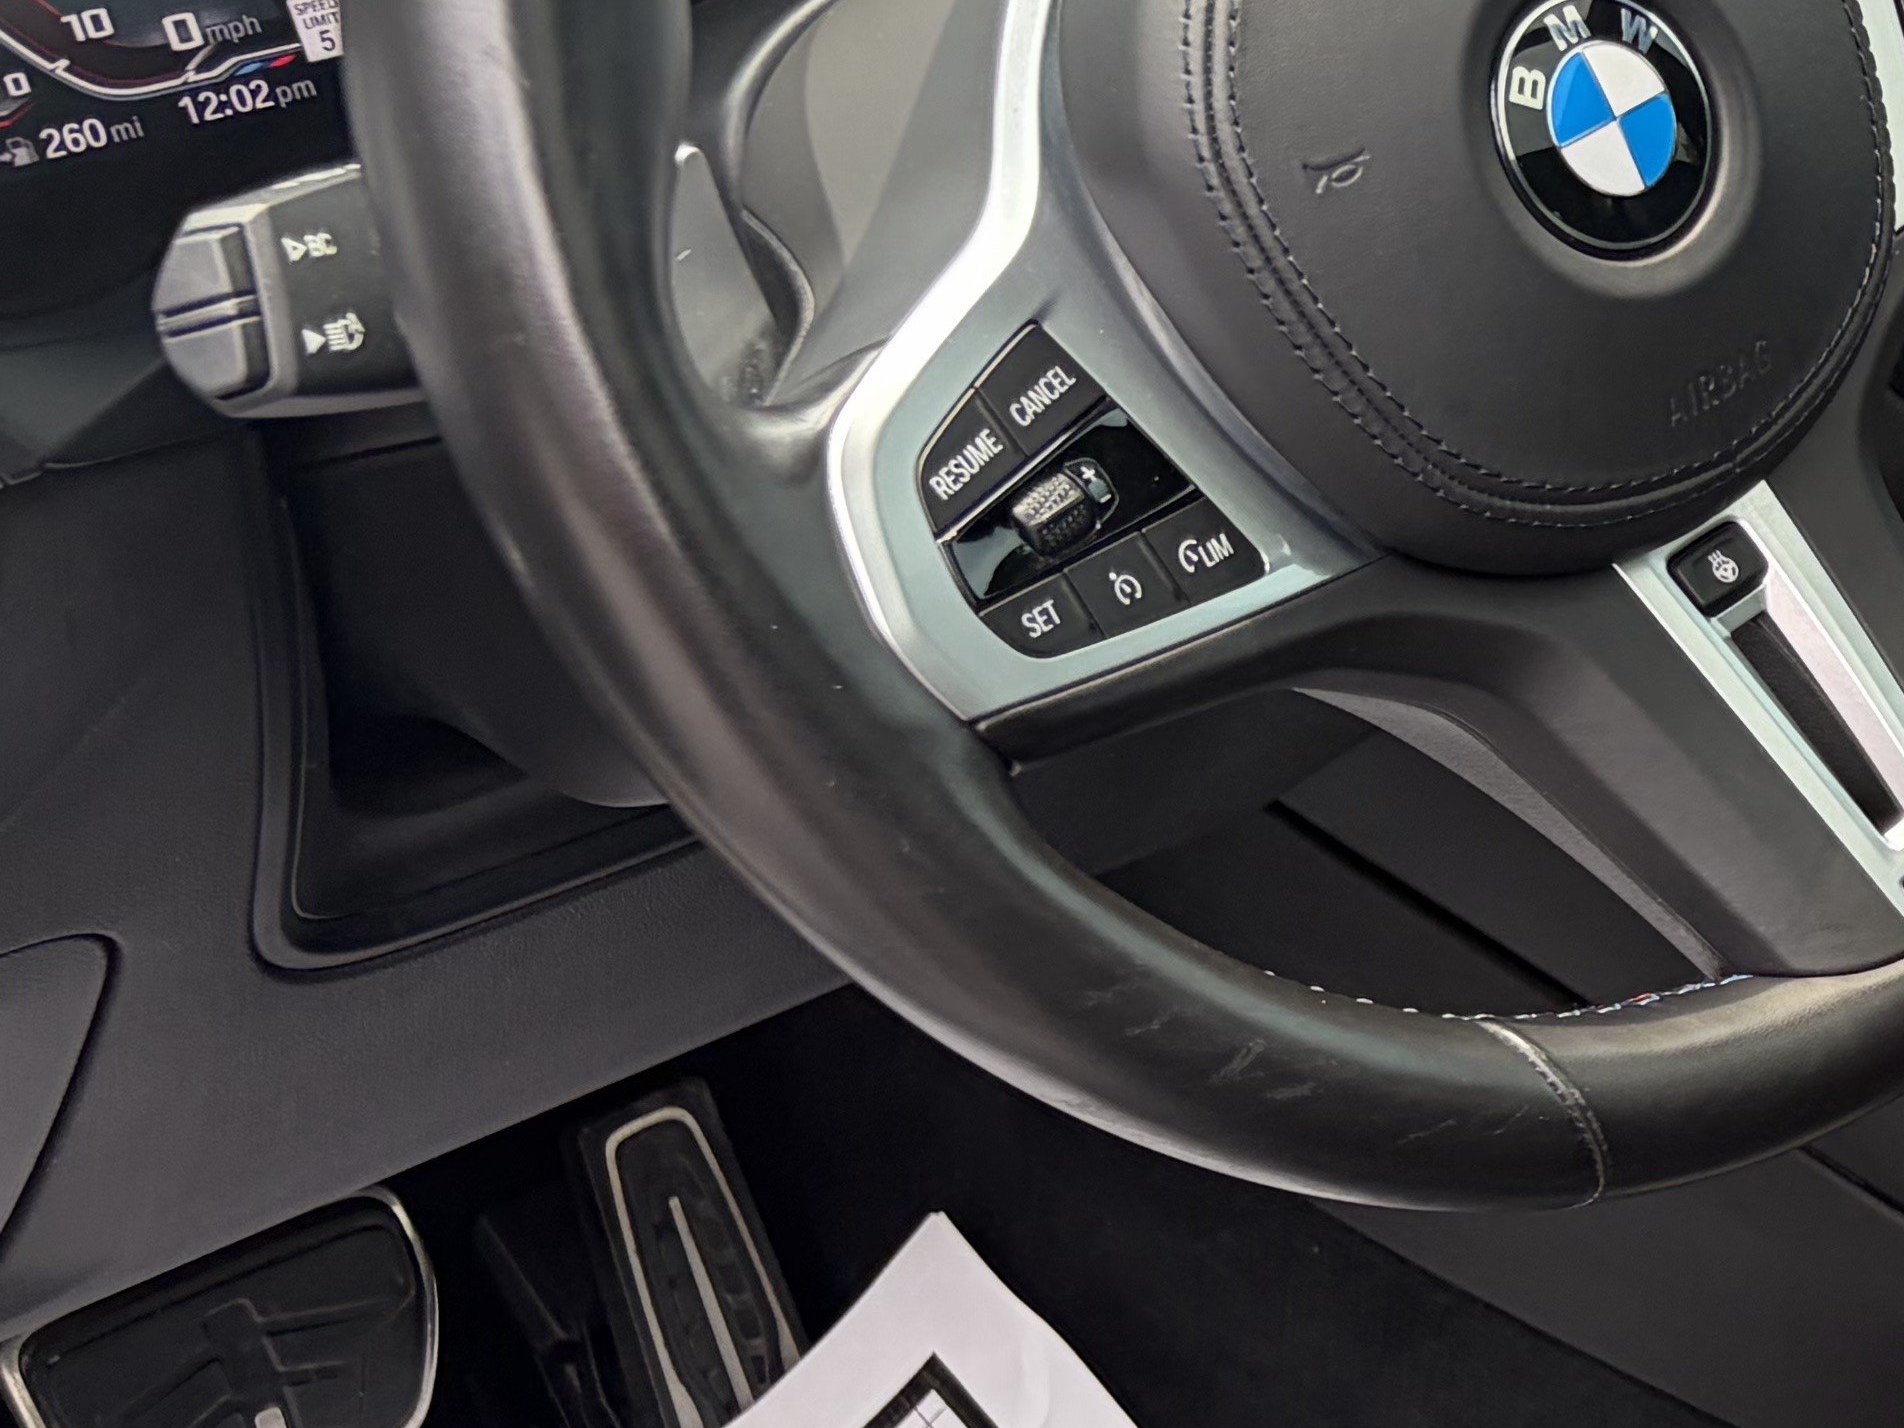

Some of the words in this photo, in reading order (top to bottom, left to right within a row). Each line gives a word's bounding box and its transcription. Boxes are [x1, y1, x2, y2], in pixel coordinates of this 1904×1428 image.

[60, 7, 115, 42] 10
[161, 12, 204, 52] 0
[204, 14, 263, 46] mph
[301, 10, 340, 31] LIMIT
[1508, 4, 1659, 111] BMW
[177, 79, 275, 125] 12:02
[275, 79, 318, 109] pm
[38, 118, 109, 161] 260
[109, 114, 145, 144] mi
[1008, 366, 1078, 429] CANCEL
[1668, 338, 1774, 429] AIRBAG
[928, 428, 1004, 503] RESUME
[1197, 532, 1234, 570] LIM
[1020, 599, 1062, 639] SET
